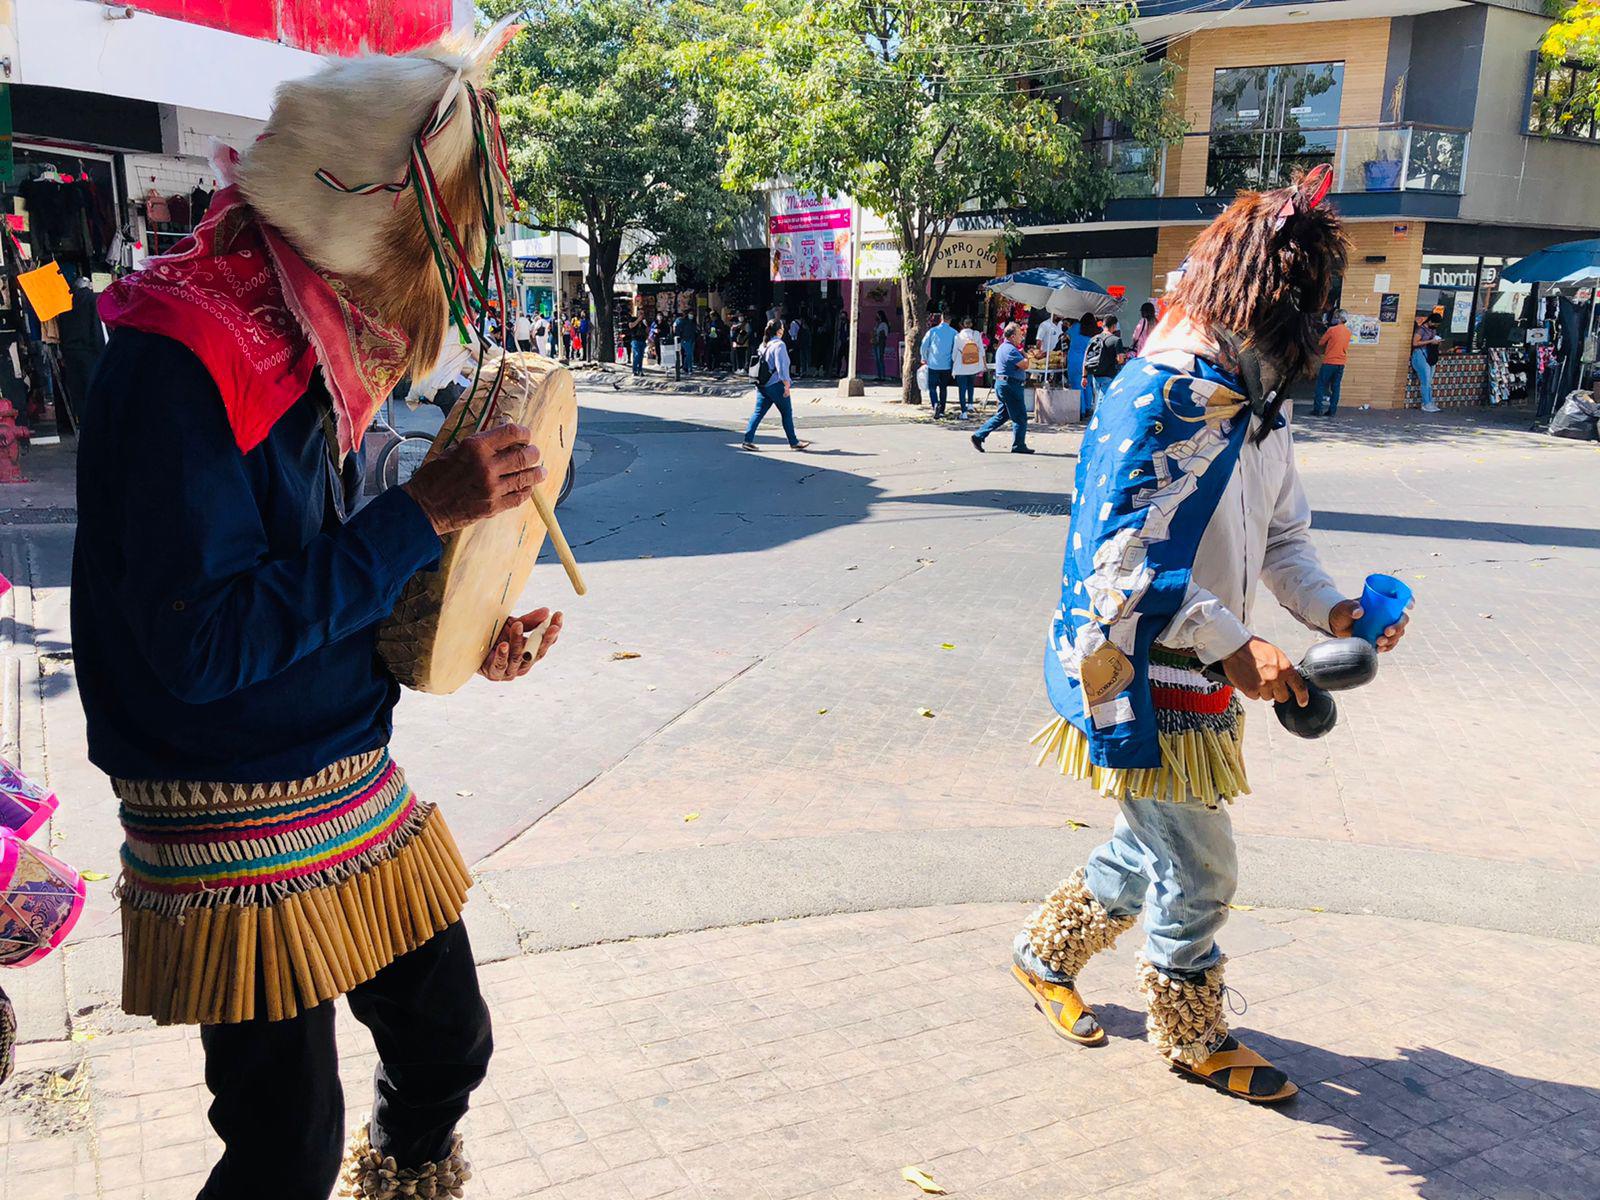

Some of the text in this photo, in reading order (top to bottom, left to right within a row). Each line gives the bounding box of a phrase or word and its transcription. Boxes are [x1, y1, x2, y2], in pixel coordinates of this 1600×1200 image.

[936, 242, 998, 264] OMPRO ORO
[525, 260, 552, 269] telcel
[947, 259, 982, 269] PLATA
